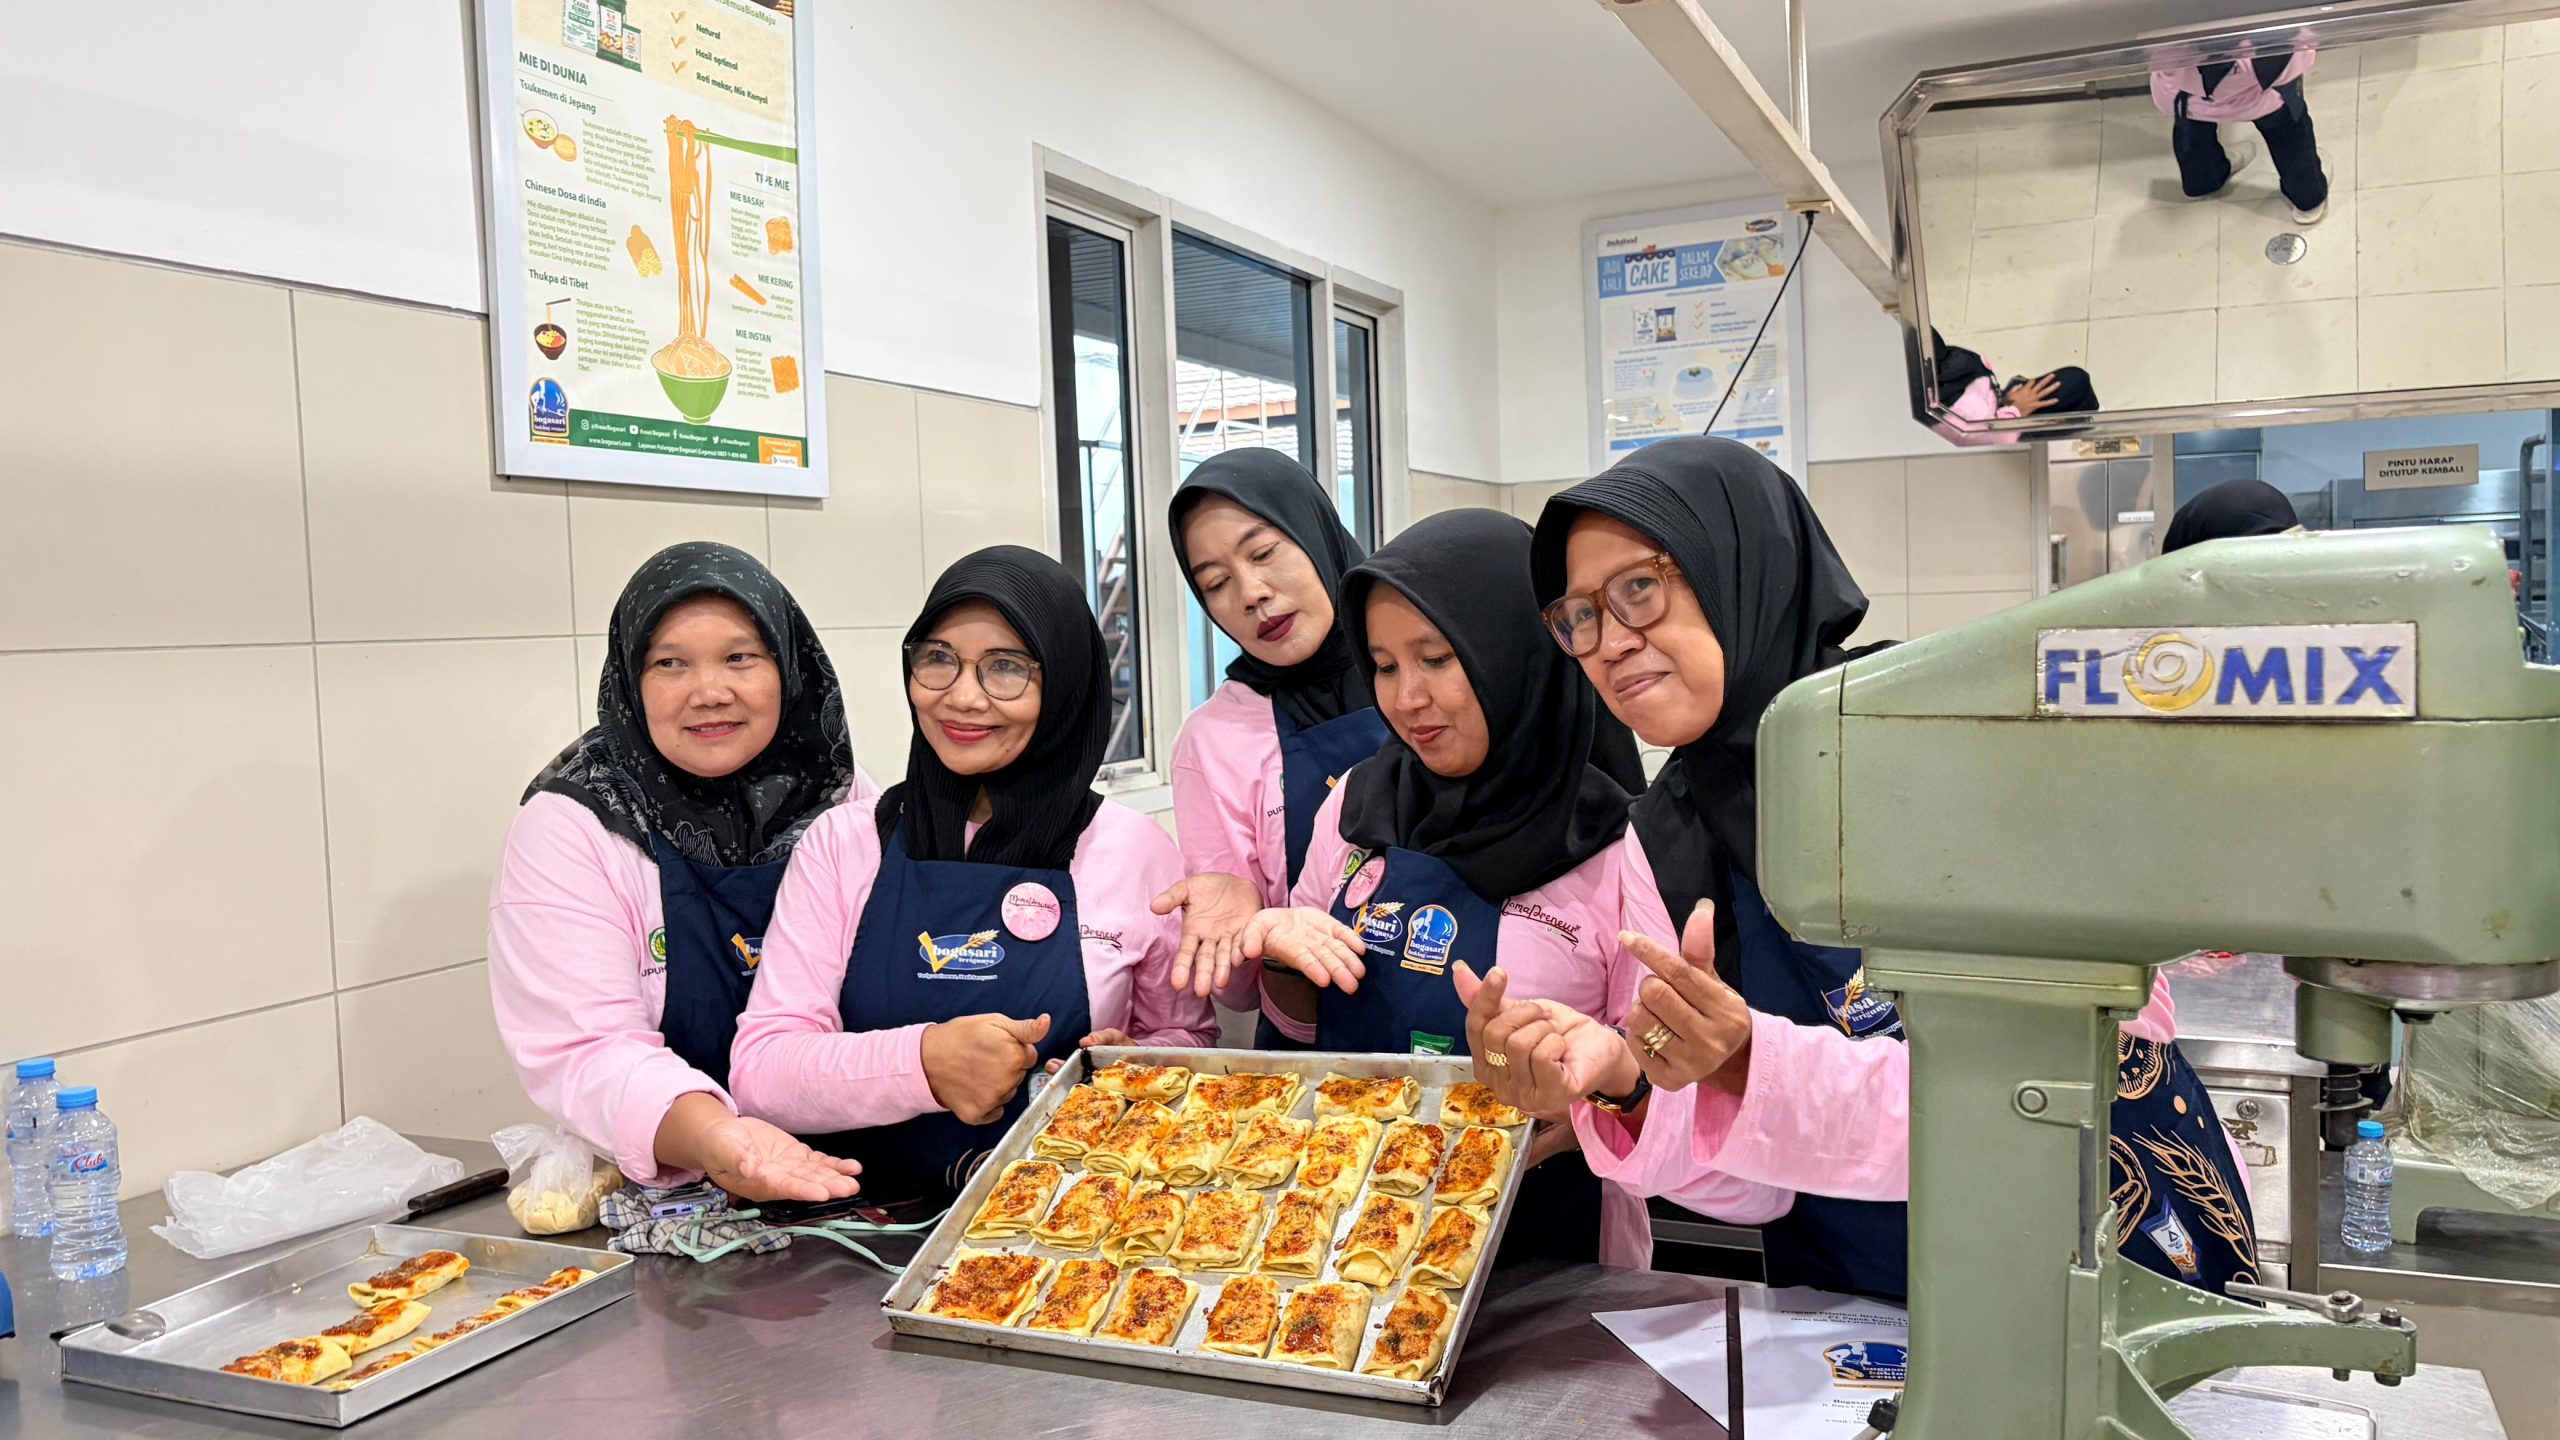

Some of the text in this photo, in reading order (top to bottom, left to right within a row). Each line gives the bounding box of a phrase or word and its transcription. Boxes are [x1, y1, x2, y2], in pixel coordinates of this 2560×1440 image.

[695, 23, 721, 40] Natural
[695, 48, 738, 70] Hasil optimal
[519, 51, 588, 86] MIE DI DUNIA
[696, 72, 710, 84] Roti
[520, 78, 597, 114] Tsukemen di Jepang
[774, 178, 790, 192] MIE
[525, 179, 606, 208] Chinese Dosa di India
[730, 191, 764, 208] MIE BASAH
[1681, 251, 1710, 265] DALAM
[1603, 260, 1621, 275] JADI
[1630, 261, 1670, 286] CAKE
[1679, 264, 1712, 281] SEKEJAP
[528, 268, 589, 290] Thukpa di Tibet
[758, 274, 793, 289] MIE KERING
[1602, 275, 1622, 291] AHLI
[736, 329, 772, 343] MIE INSTAN
[534, 415, 566, 425] bogasari
[588, 438, 631, 447] www.bogasari.com
[2388, 456, 2454, 467] PINTU HARAP
[2379, 466, 2464, 477] DITUTUP KEMBALI
[2044, 634, 2404, 710] FLOMIX
[1080, 925, 1122, 940] Preneur
[933, 945, 997, 959] bogasari
[1410, 940, 1446, 954] bogasari
[74, 1153, 102, 1170] Club
